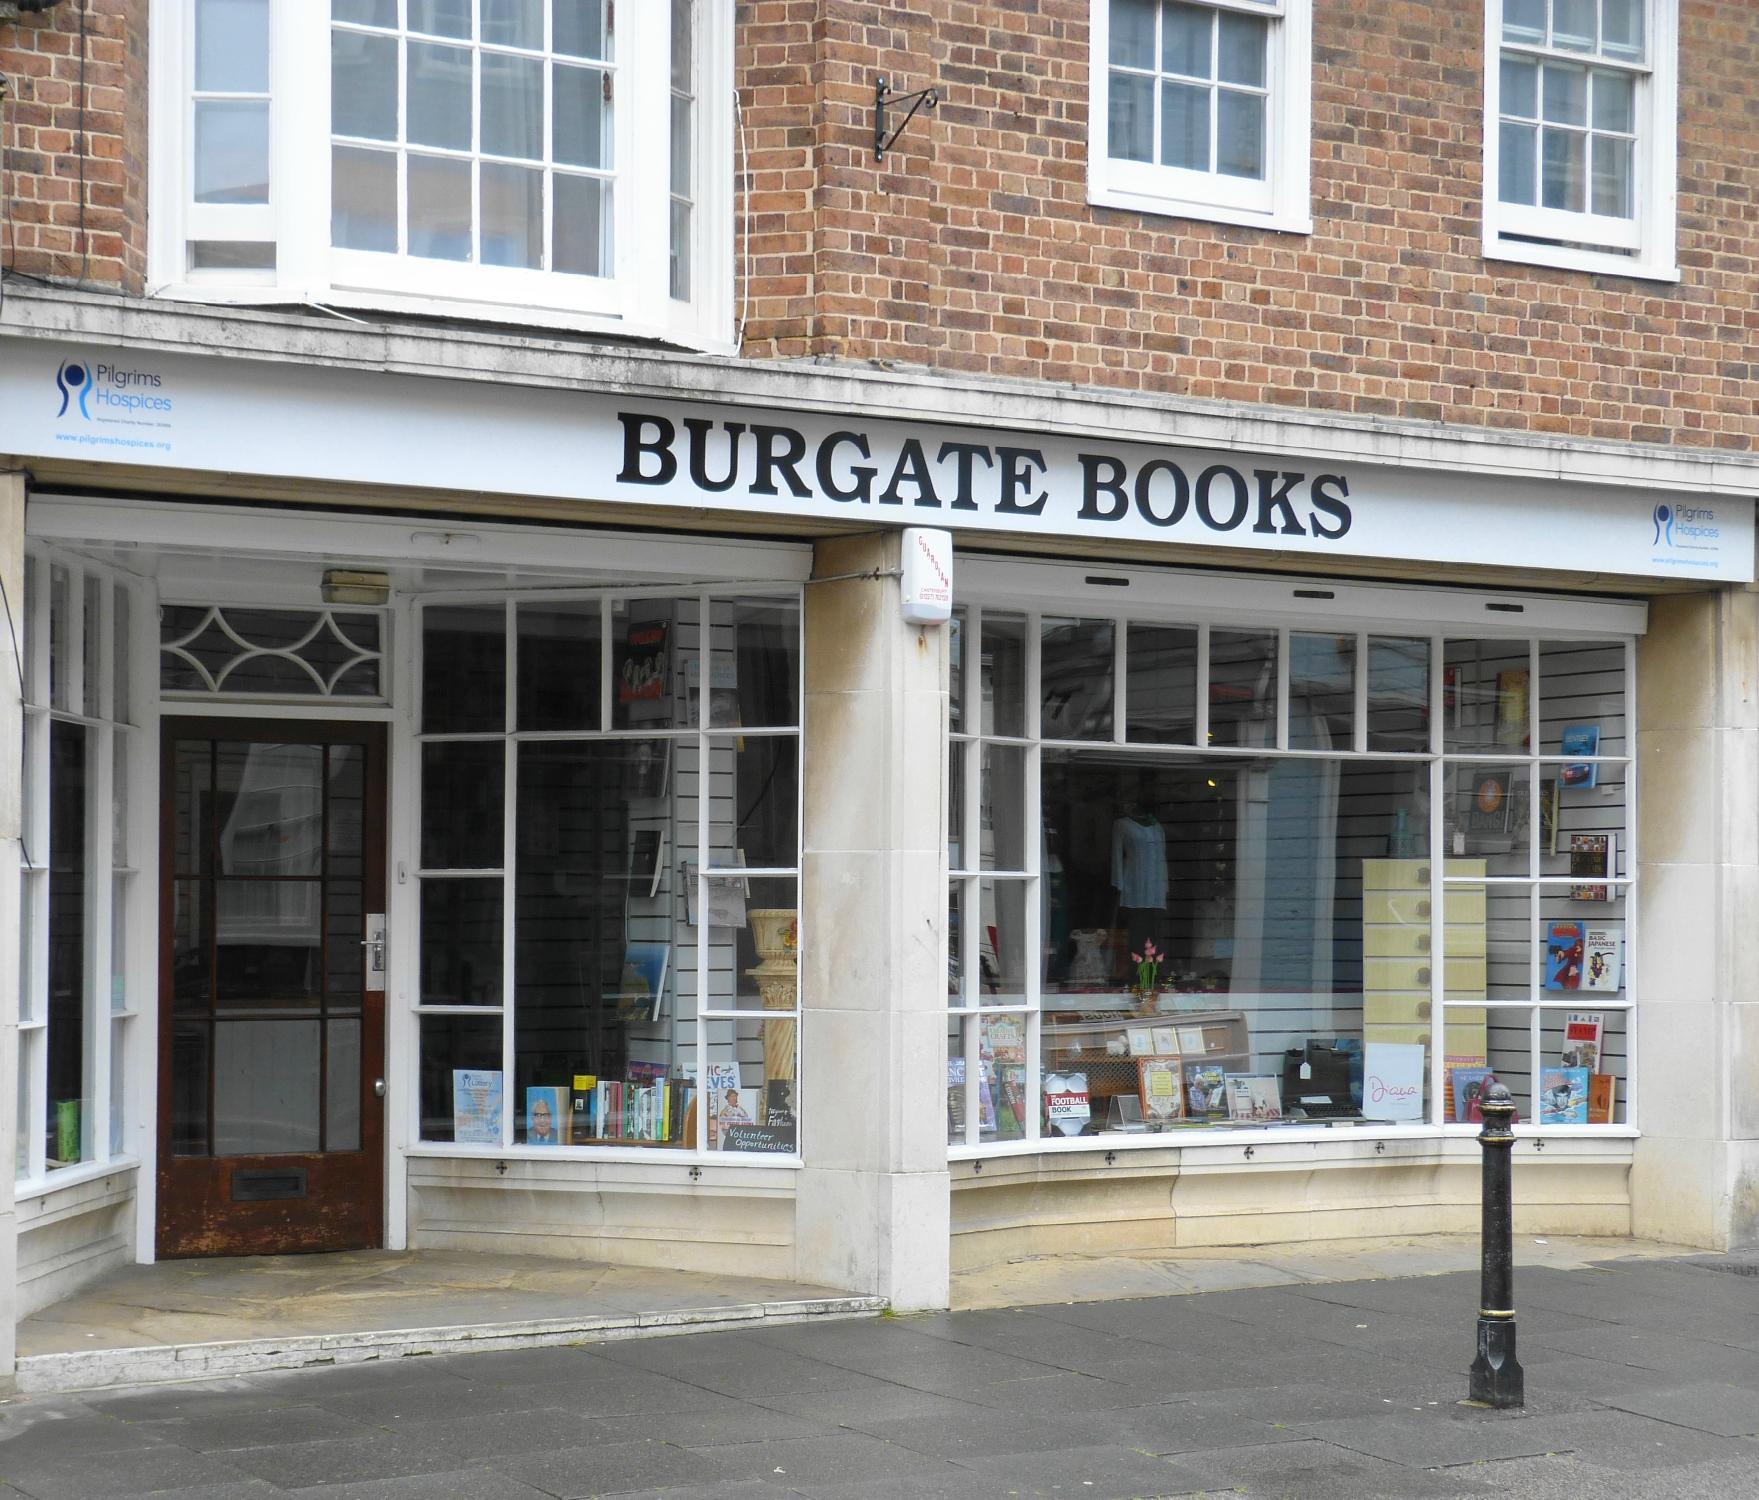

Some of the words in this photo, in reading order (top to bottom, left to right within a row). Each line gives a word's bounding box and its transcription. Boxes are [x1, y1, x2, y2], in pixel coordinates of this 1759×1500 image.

[97, 364, 162, 388] Pilgrims
[97, 388, 172, 412] Hospices
[56, 433, 172, 451] www.pilgrimshospices.org
[617, 412, 1049, 517] BURGATE
[1077, 453, 1352, 540] BOOKS
[1676, 504, 1714, 522] Pilgrims
[1675, 523, 1720, 540] Hospices
[919, 536, 949, 588] GUARDIAN
[1051, 1096, 1088, 1105] FOOTBALL
[729, 1127, 775, 1142] Volunteer
[735, 1139, 794, 1153] Opportunities
